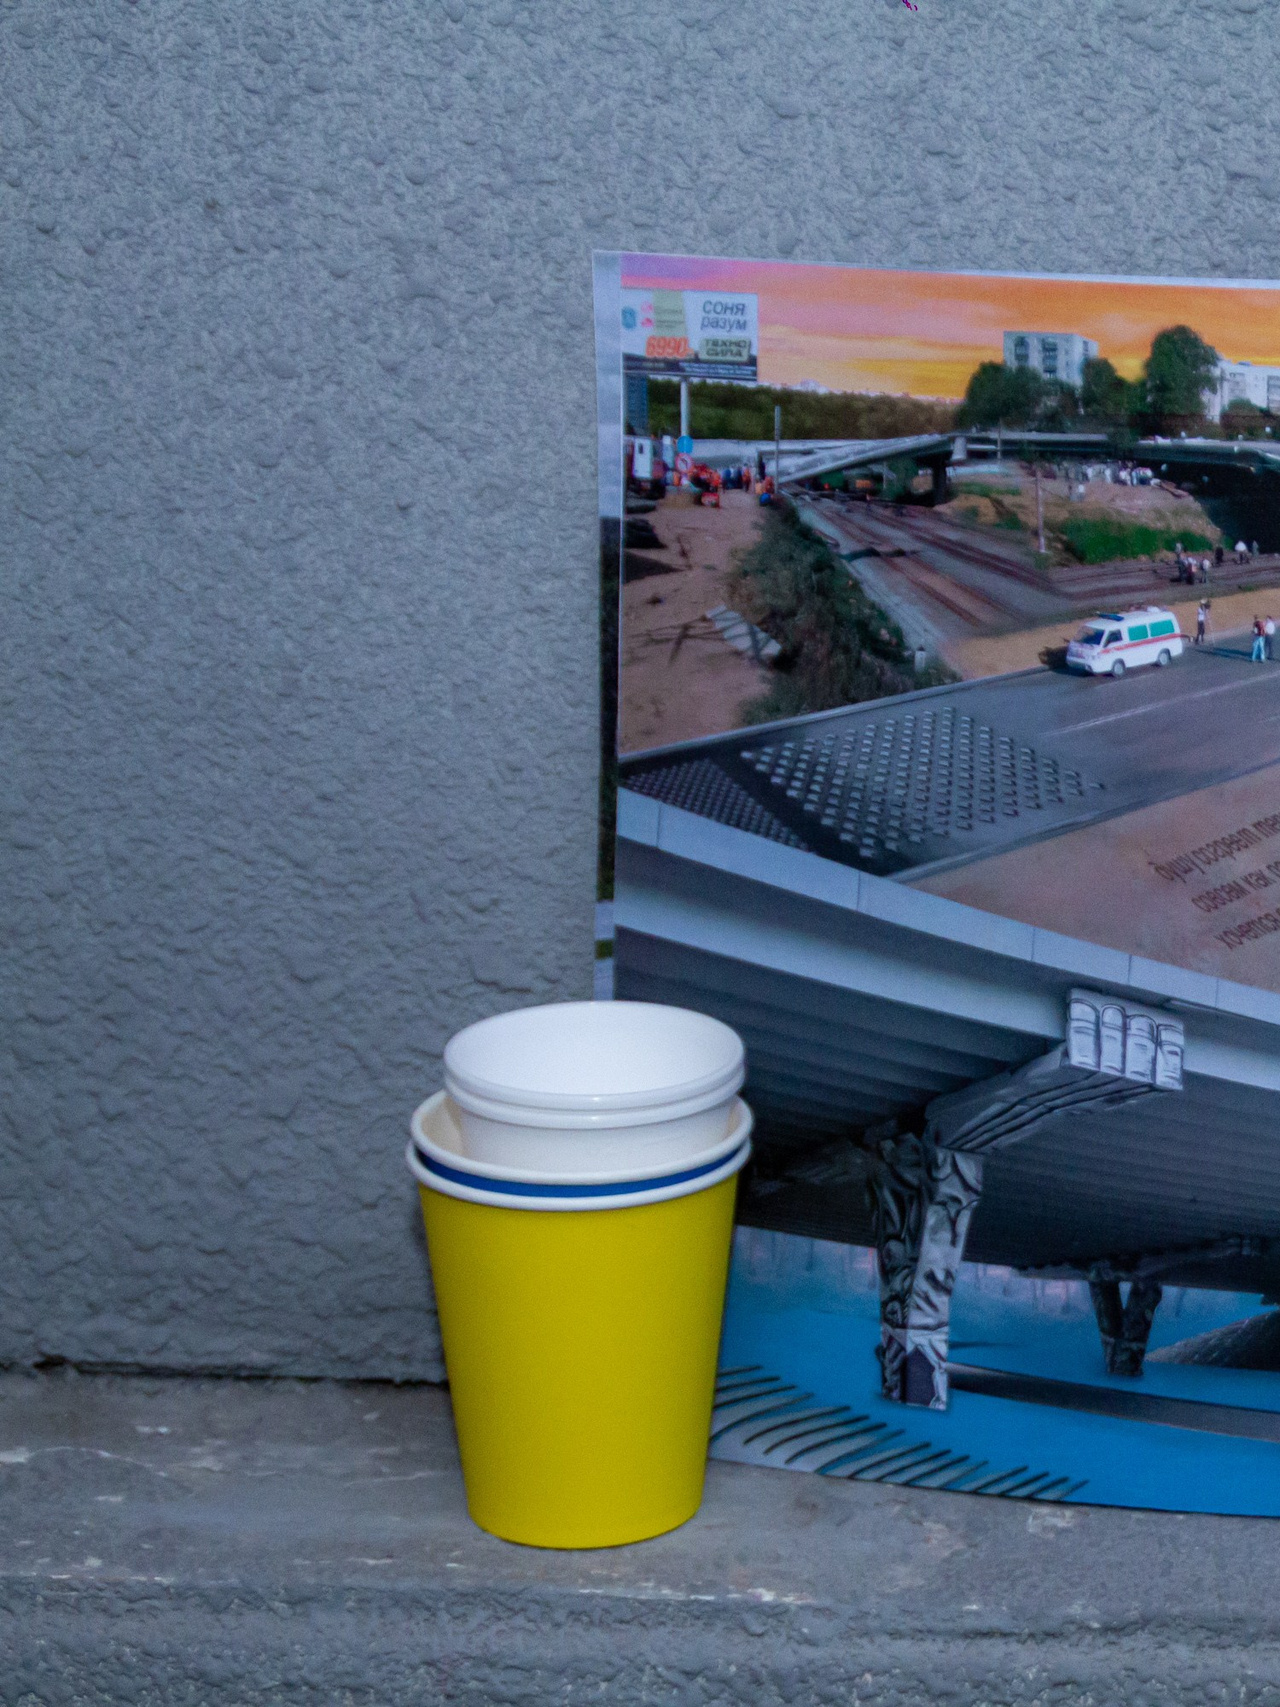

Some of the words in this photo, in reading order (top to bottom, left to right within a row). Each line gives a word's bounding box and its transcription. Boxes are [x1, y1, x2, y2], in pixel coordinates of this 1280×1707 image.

[700, 316, 747, 334] разум
[1148, 853, 1205, 883] душу
[1192, 827, 1263, 865] согреет
[1190, 880, 1251, 913] совсем
[1240, 868, 1278, 891] как
